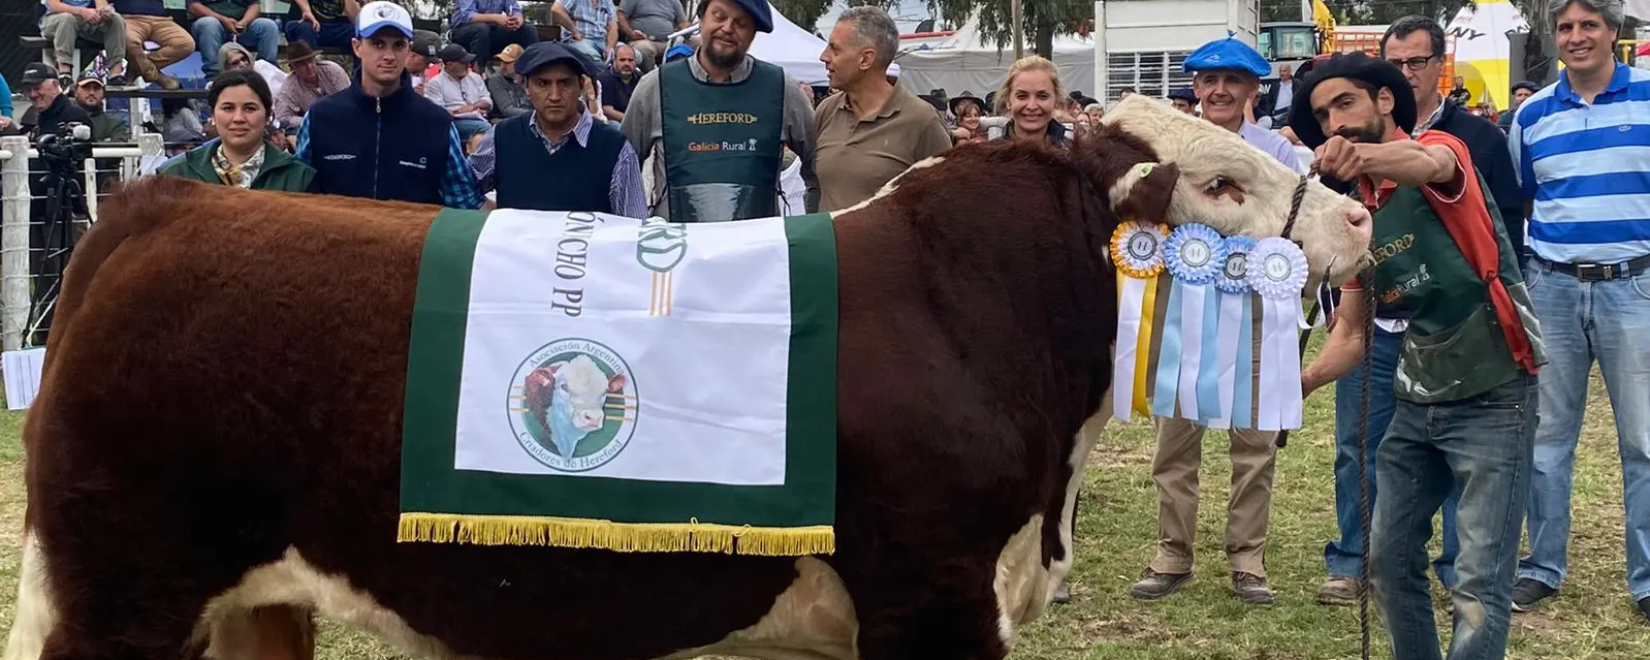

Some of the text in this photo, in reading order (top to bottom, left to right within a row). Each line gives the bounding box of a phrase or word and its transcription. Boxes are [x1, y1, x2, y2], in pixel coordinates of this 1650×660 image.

[691, 112, 754, 124] HEREFORD
[688, 141, 747, 151] Galicia Rural
[551, 286, 584, 318] PP
[530, 342, 625, 374] Asociación Argentina
[520, 431, 623, 469] Criadores de Hereford
